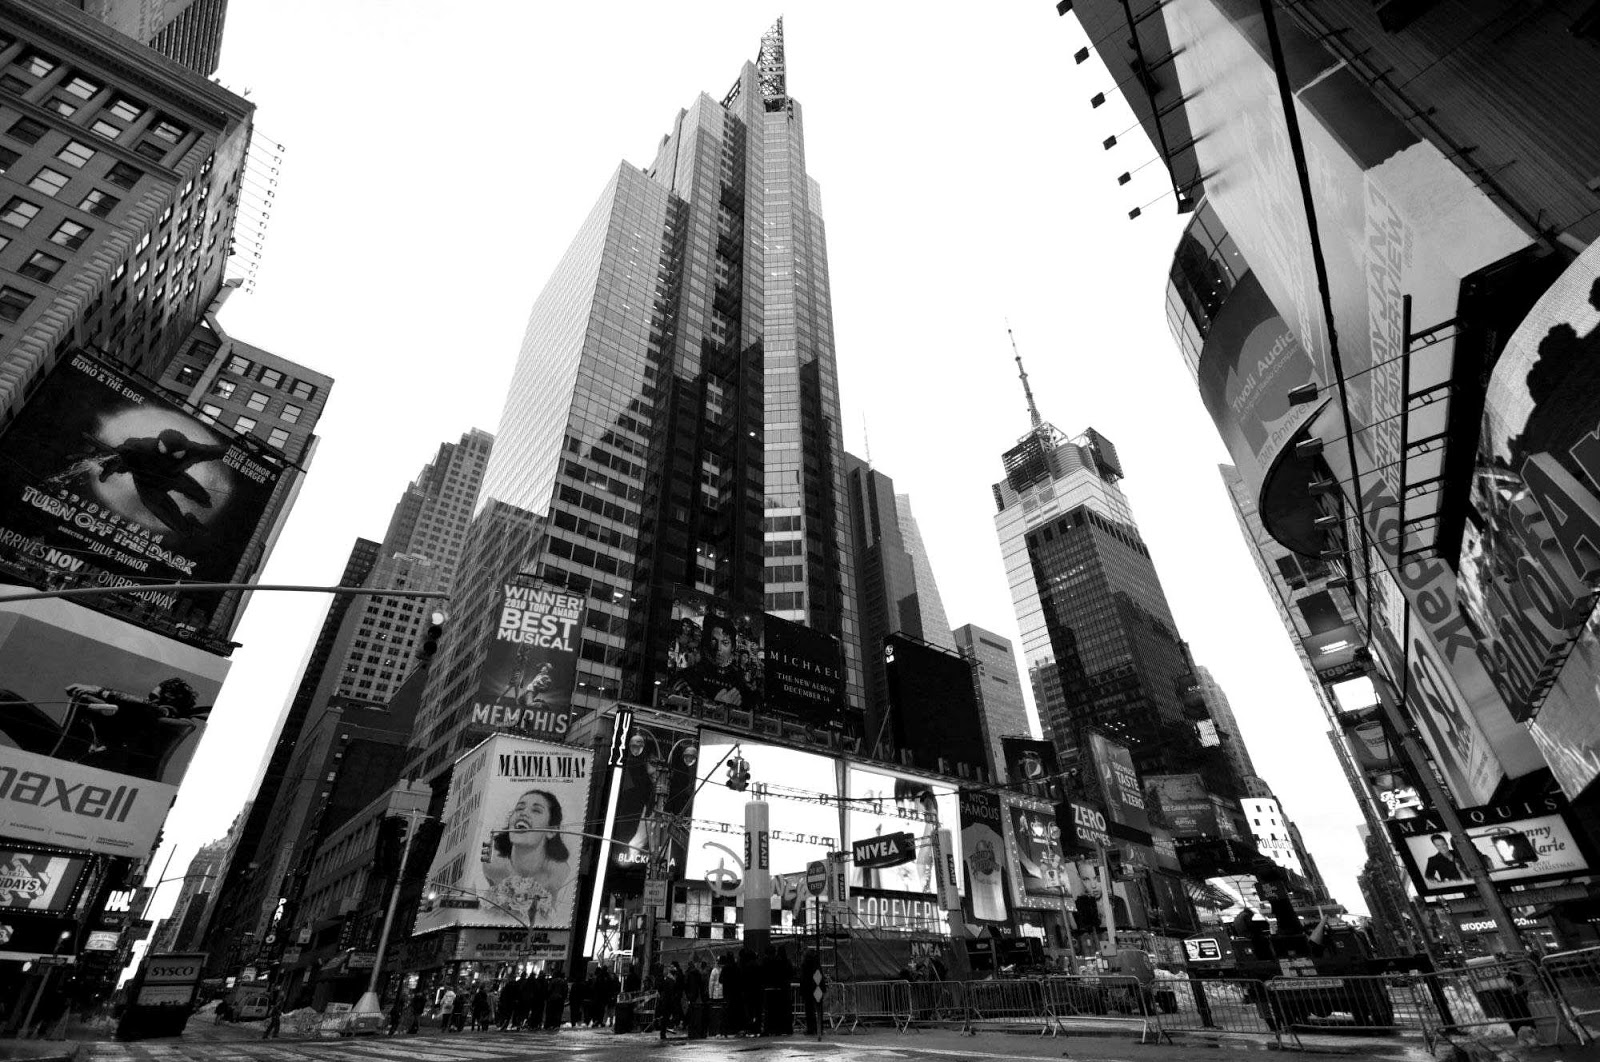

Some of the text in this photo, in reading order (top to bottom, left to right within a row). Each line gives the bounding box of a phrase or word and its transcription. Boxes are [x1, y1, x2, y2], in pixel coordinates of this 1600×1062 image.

[71, 357, 146, 405] BONO & THE EDGE
[1232, 372, 1255, 414] Tivoli
[222, 454, 241, 470] GLEN
[245, 458, 272, 478] TAYMOR
[20, 485, 75, 522] TURN
[74, 512, 115, 537] OFF
[145, 545, 198, 576] DARK
[45, 548, 85, 573] NOV
[88, 540, 114, 559] JULIE
[114, 551, 149, 574] TAYMOR
[1362, 478, 1480, 666] Kodak
[504, 584, 585, 612] WINNER!
[504, 598, 580, 619] 2010 TONY AWARD
[500, 608, 578, 639] BEST
[496, 629, 573, 652] MUSICAL
[1473, 570, 1568, 724] Bank
[770, 651, 842, 680] MICHAEL
[777, 672, 836, 695] THE NEW ALBUM
[783, 683, 823, 701] DECEMBER
[471, 703, 568, 734] MEMPHIS
[497, 753, 585, 778] MAMMA MIA!
[1116, 770, 1140, 791] TASTE
[961, 803, 999, 821] FAMOUS
[1071, 803, 1107, 832] ZERO
[1399, 797, 1558, 836] MAQUIS
[856, 838, 900, 862] NIVEA
[857, 897, 934, 932] FOREVER
[1461, 919, 1496, 931] eropost
[911, 943, 941, 956] NIVEA
[151, 965, 194, 977] SYSCO
